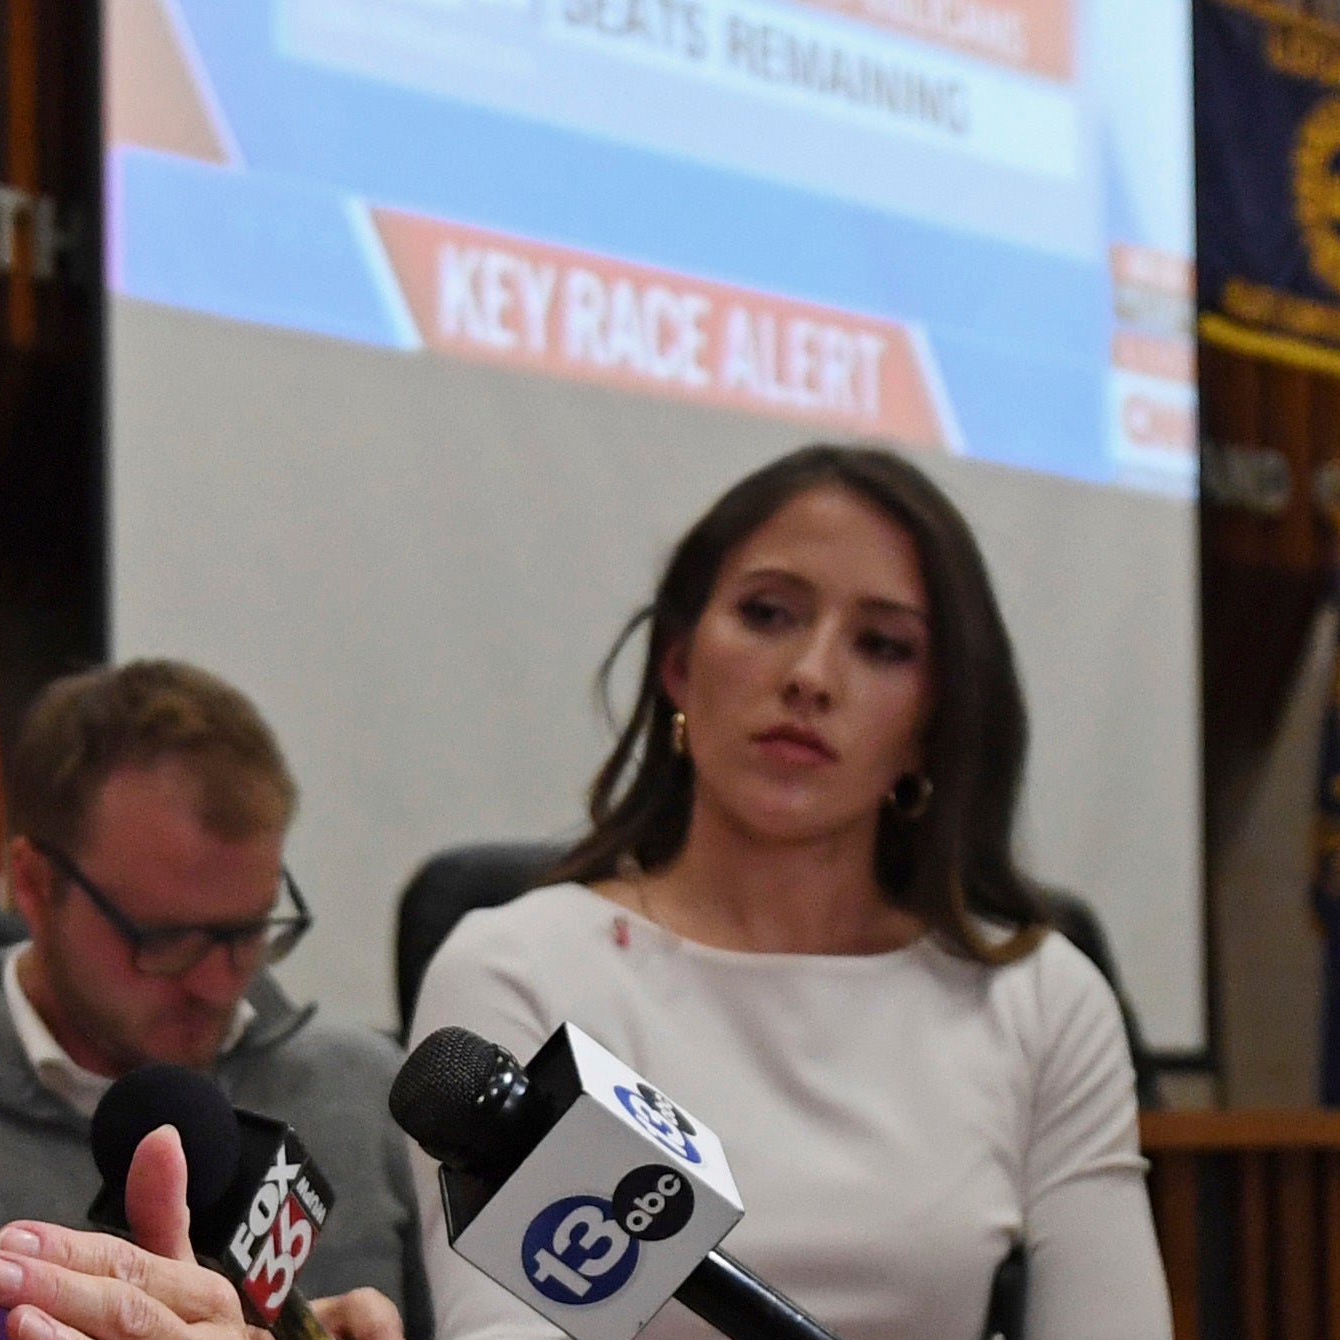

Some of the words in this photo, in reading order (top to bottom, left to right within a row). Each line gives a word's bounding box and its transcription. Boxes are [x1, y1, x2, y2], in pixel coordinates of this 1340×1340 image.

[724, 14, 969, 137] REMAINING
[438, 243, 556, 353] KEY
[566, 268, 712, 387] RACE
[721, 307, 885, 418] ALERT
[229, 1140, 302, 1272] FOX
[249, 1198, 313, 1309] 36
[531, 1204, 633, 1298] 13
[625, 1172, 682, 1232] abc
